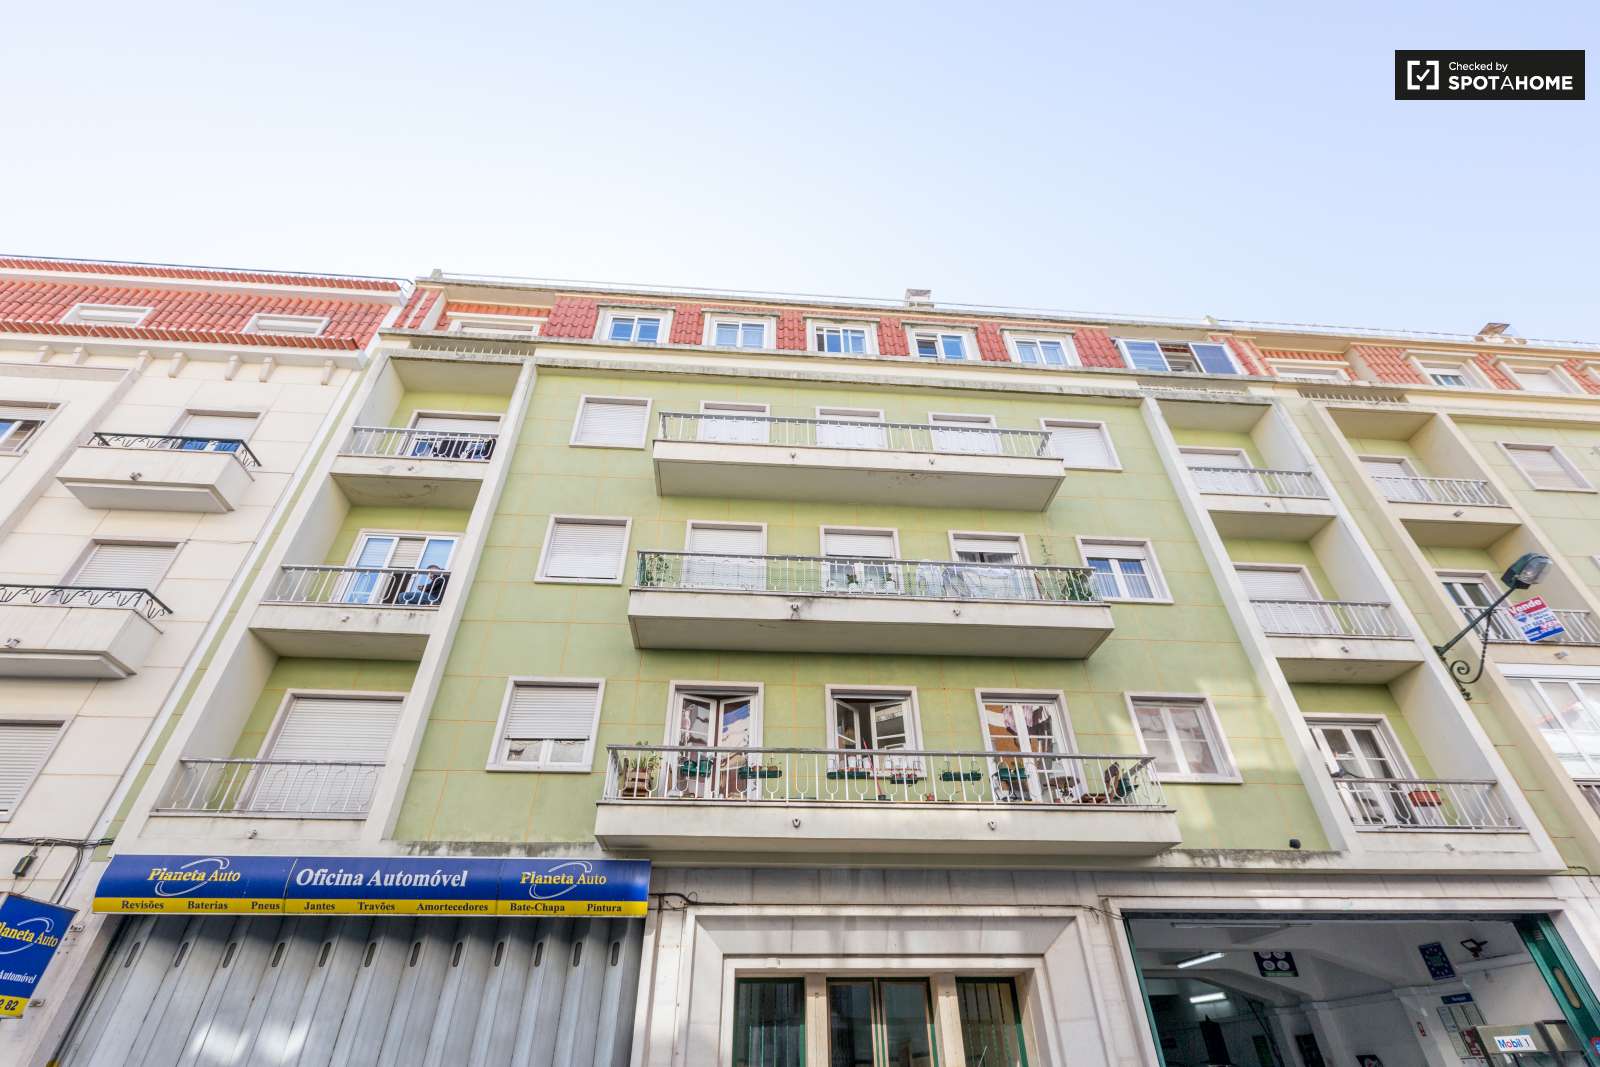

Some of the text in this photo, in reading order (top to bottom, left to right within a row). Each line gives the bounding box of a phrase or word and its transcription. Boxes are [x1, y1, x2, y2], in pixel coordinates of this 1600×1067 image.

[147, 867, 241, 882] Planeta Auto
[296, 868, 468, 887] Oficina Automóvel
[519, 872, 607, 885] Planeta Auto
[121, 900, 622, 913] Revisões Baterias Pneus Jantes Travões Amortecedores Bate-Chapa Pintura
[35, 932, 58, 947] Auto
[1497, 1038, 1523, 1049] Mobil
